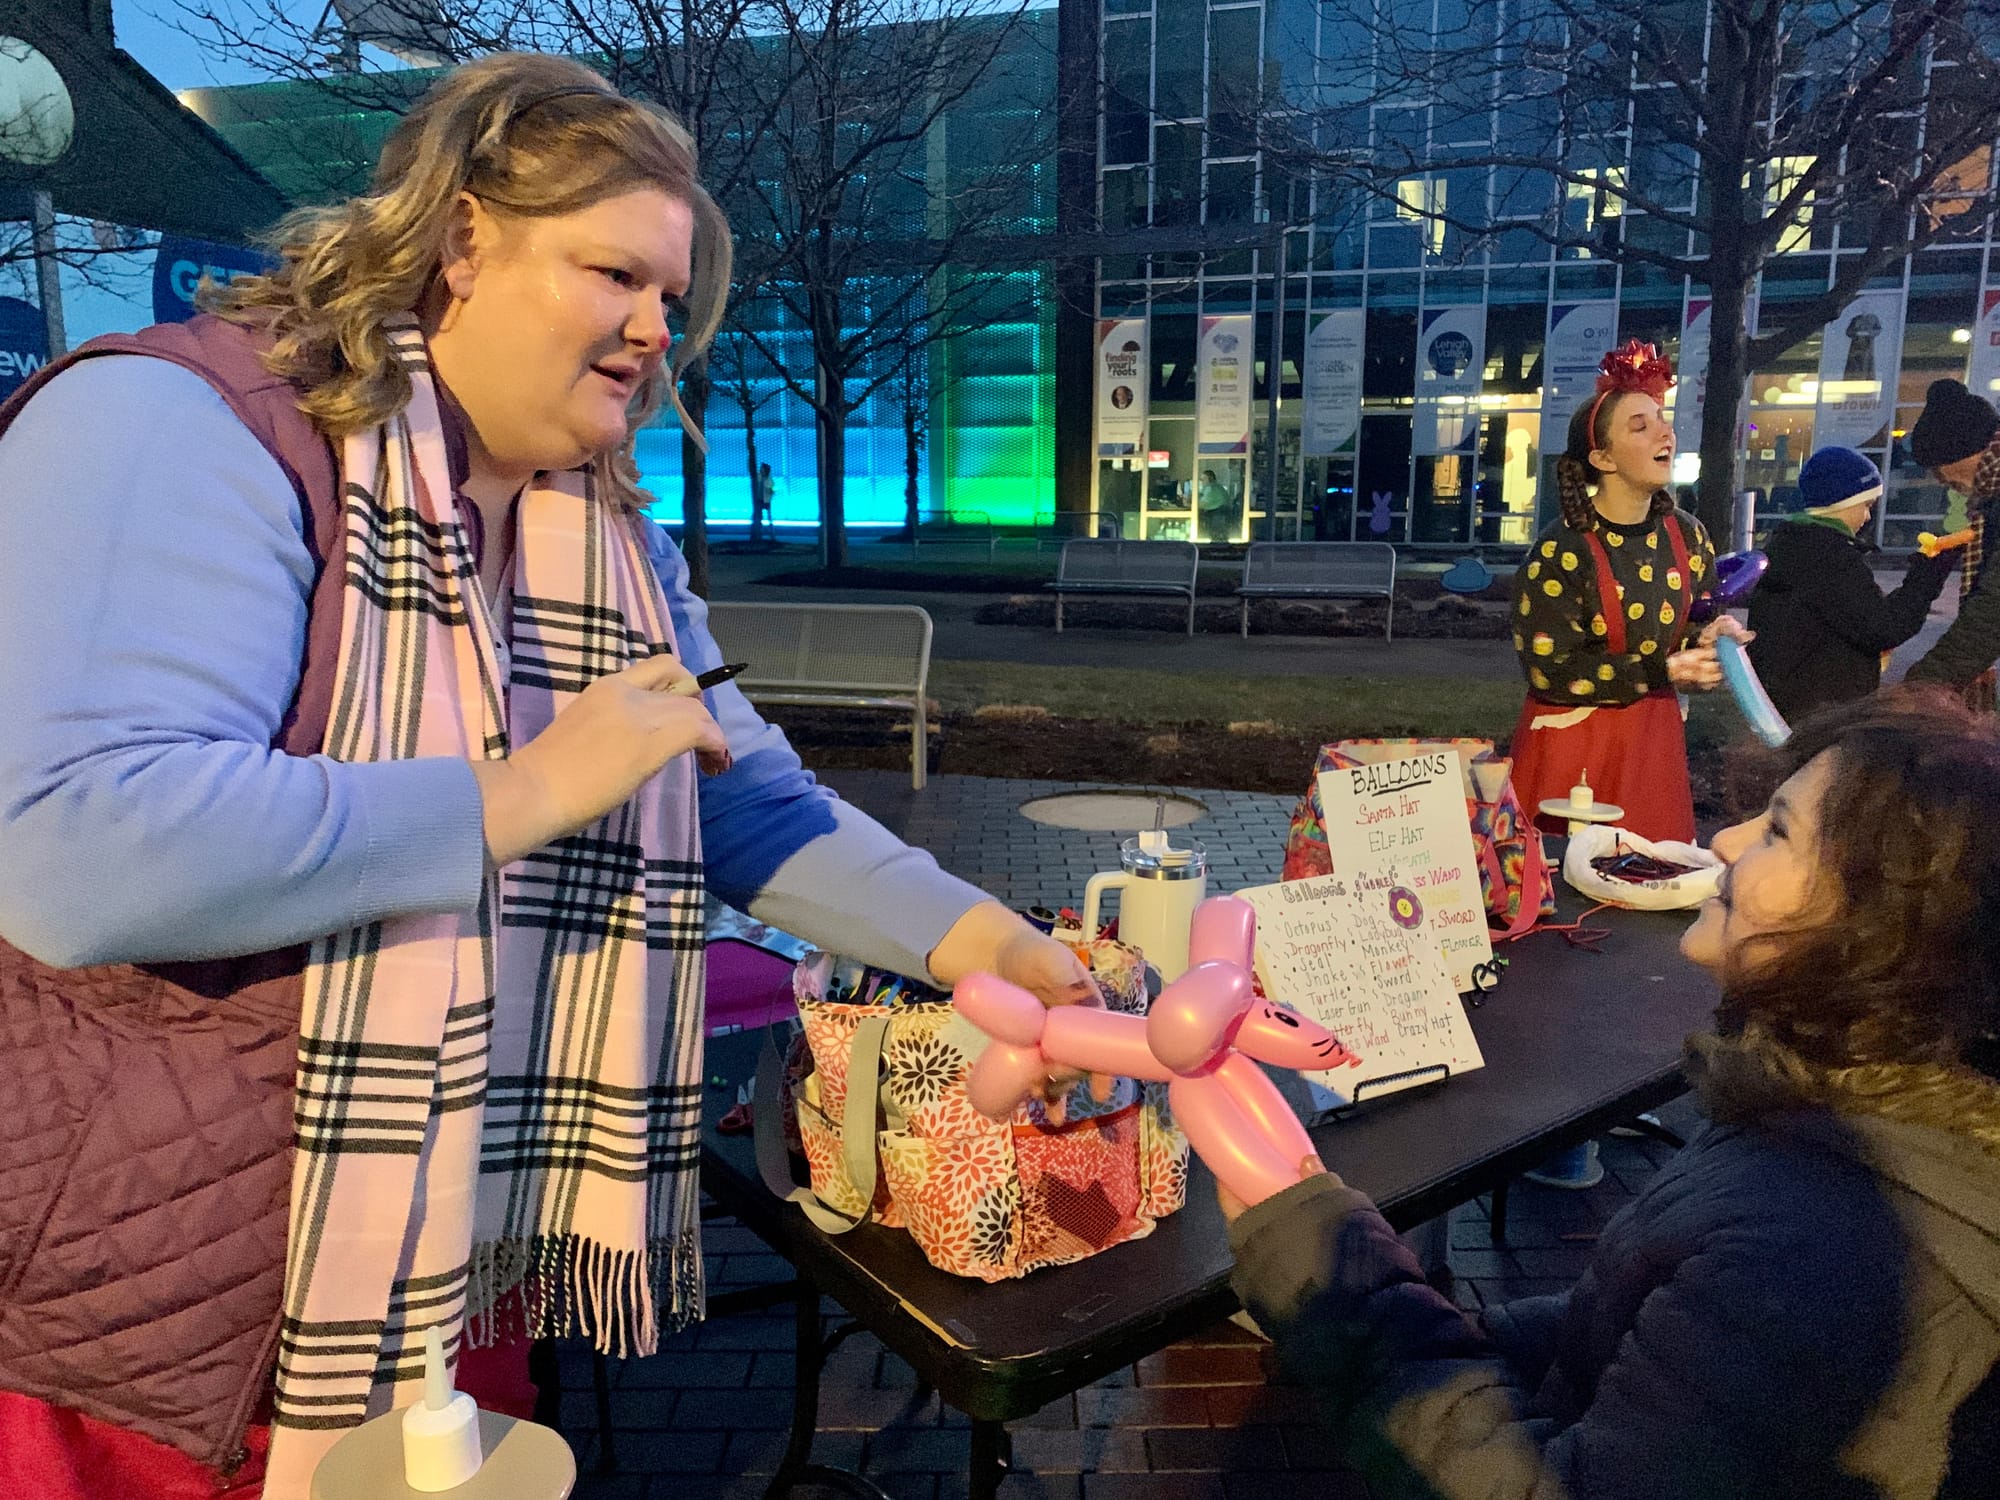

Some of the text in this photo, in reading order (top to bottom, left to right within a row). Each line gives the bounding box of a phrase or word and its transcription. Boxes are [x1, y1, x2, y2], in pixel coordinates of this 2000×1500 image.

[1105, 351, 1137, 365] finding
[1107, 362, 1131, 373] your
[1112, 365, 1137, 376] roots
[1351, 754, 1447, 795] BALLOONS
[1284, 920, 1332, 939] Octopus
[1351, 913, 1377, 930] Dog
[1285, 935, 1346, 958] Dragonfly
[1361, 939, 1410, 959] Monkey
[1300, 951, 1331, 972] Seal
[1370, 954, 1415, 974] Flower
[1305, 967, 1348, 987] Snake
[1377, 968, 1412, 989] Sword
[1306, 987, 1348, 1006] Turtle
[1381, 989, 1423, 1008] Dragon
[1318, 1000, 1372, 1021] Laser Gun
[1391, 1006, 1428, 1025] Bunny
[1332, 1017, 1374, 1039] tterfly
[1398, 1022, 1429, 1038] Crazy
[1363, 1029, 1390, 1048] Wand
